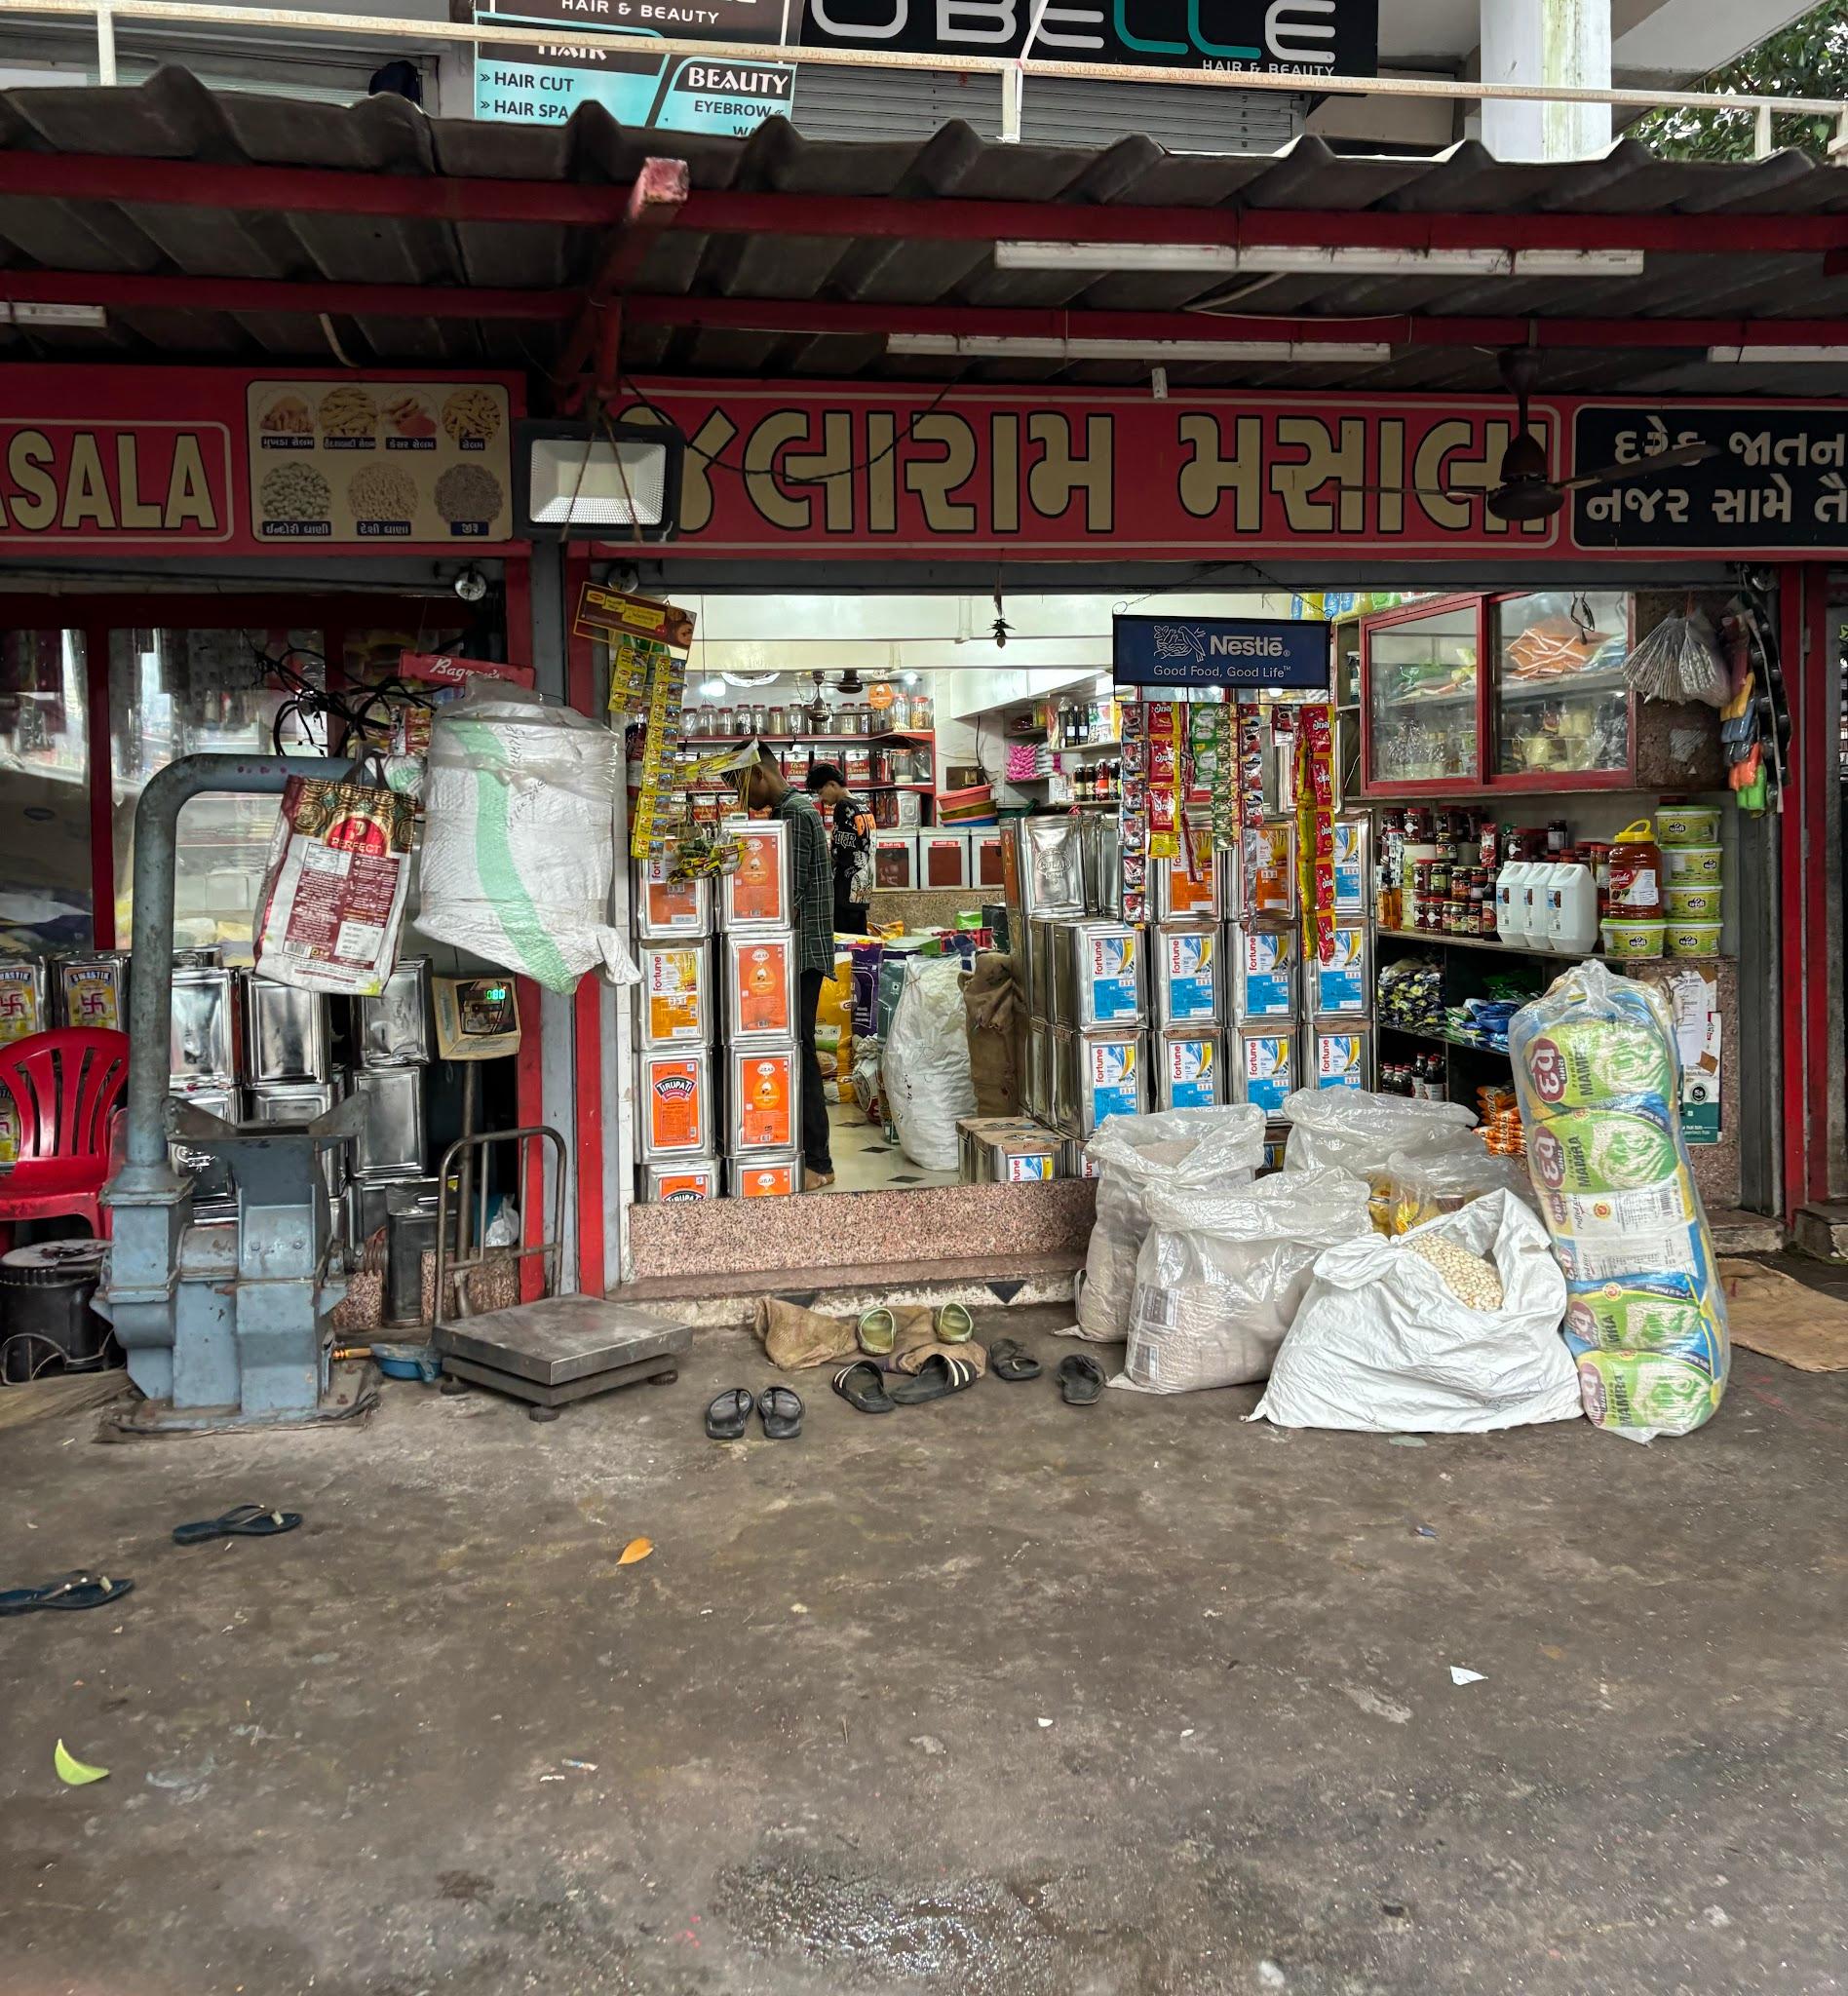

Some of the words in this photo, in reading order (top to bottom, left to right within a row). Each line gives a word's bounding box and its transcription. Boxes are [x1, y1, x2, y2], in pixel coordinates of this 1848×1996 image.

[561, 0, 612, 15] HAIR
[618, 3, 631, 16] &
[640, 5, 720, 24] BEAUTY
[494, 71, 535, 91] HAIR
[540, 74, 574, 94] CUT
[687, 65, 789, 96] BEAUTY
[494, 99, 535, 117] HAIR
[538, 102, 568, 120] SPA
[694, 99, 772, 118] EYEBROW
[1586, 487, 1690, 523] નજર
[1711, 473, 1792, 523] સામે
[1153, 665, 1186, 676] Good
[1190, 665, 1222, 678] Food,
[1227, 666, 1259, 677] Good
[331, 836, 382, 854] PERFECT
[653, 956, 662, 992] fortune
[1568, 1135, 1591, 1187] MAMRA
